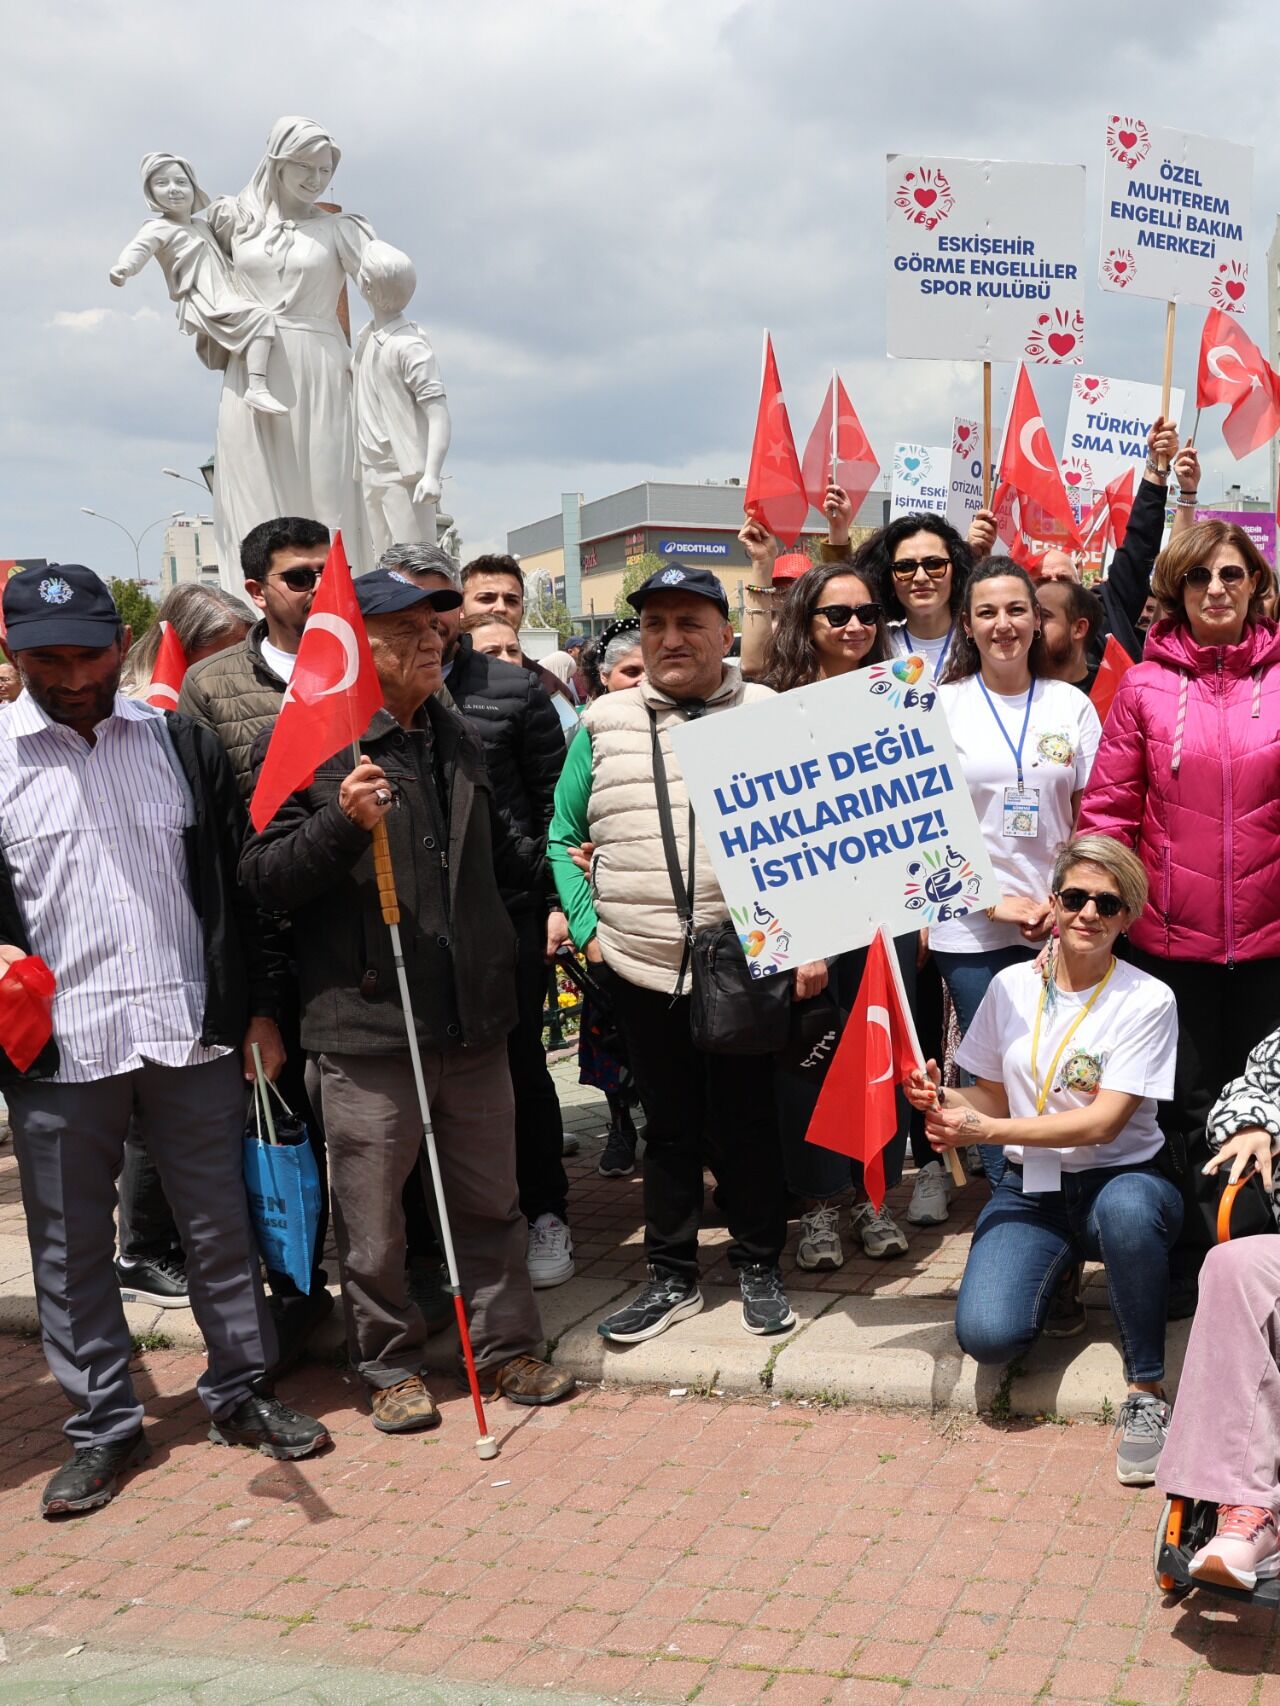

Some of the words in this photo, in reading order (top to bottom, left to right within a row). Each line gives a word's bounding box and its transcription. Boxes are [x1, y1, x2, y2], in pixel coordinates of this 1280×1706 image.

[1160, 158, 1203, 188] ÖZEL
[1127, 180, 1230, 216] MUHTEREM
[1110, 200, 1182, 230] ENGELLİ
[1186, 214, 1243, 242] BAKIM
[938, 234, 1035, 257] ESKİŞEHİR
[1137, 229, 1216, 260] MERKEZİ
[893, 254, 965, 276] GÖRME
[970, 257, 1077, 280] ENGELLİLER
[920, 278, 971, 297] SPOR
[976, 279, 1051, 300] KULÜBÜ
[1086, 411, 1152, 437] TÜRKİY
[1071, 433, 1114, 454] SMA
[895, 495, 933, 510] İŞİTME
[677, 543, 726, 554] DECATHLON
[713, 758, 821, 816] LÜTUF
[828, 723, 934, 781] DEĞİL
[719, 763, 954, 858] HAKLARIMIZI
[749, 809, 949, 892] İSTİYORUZ!
